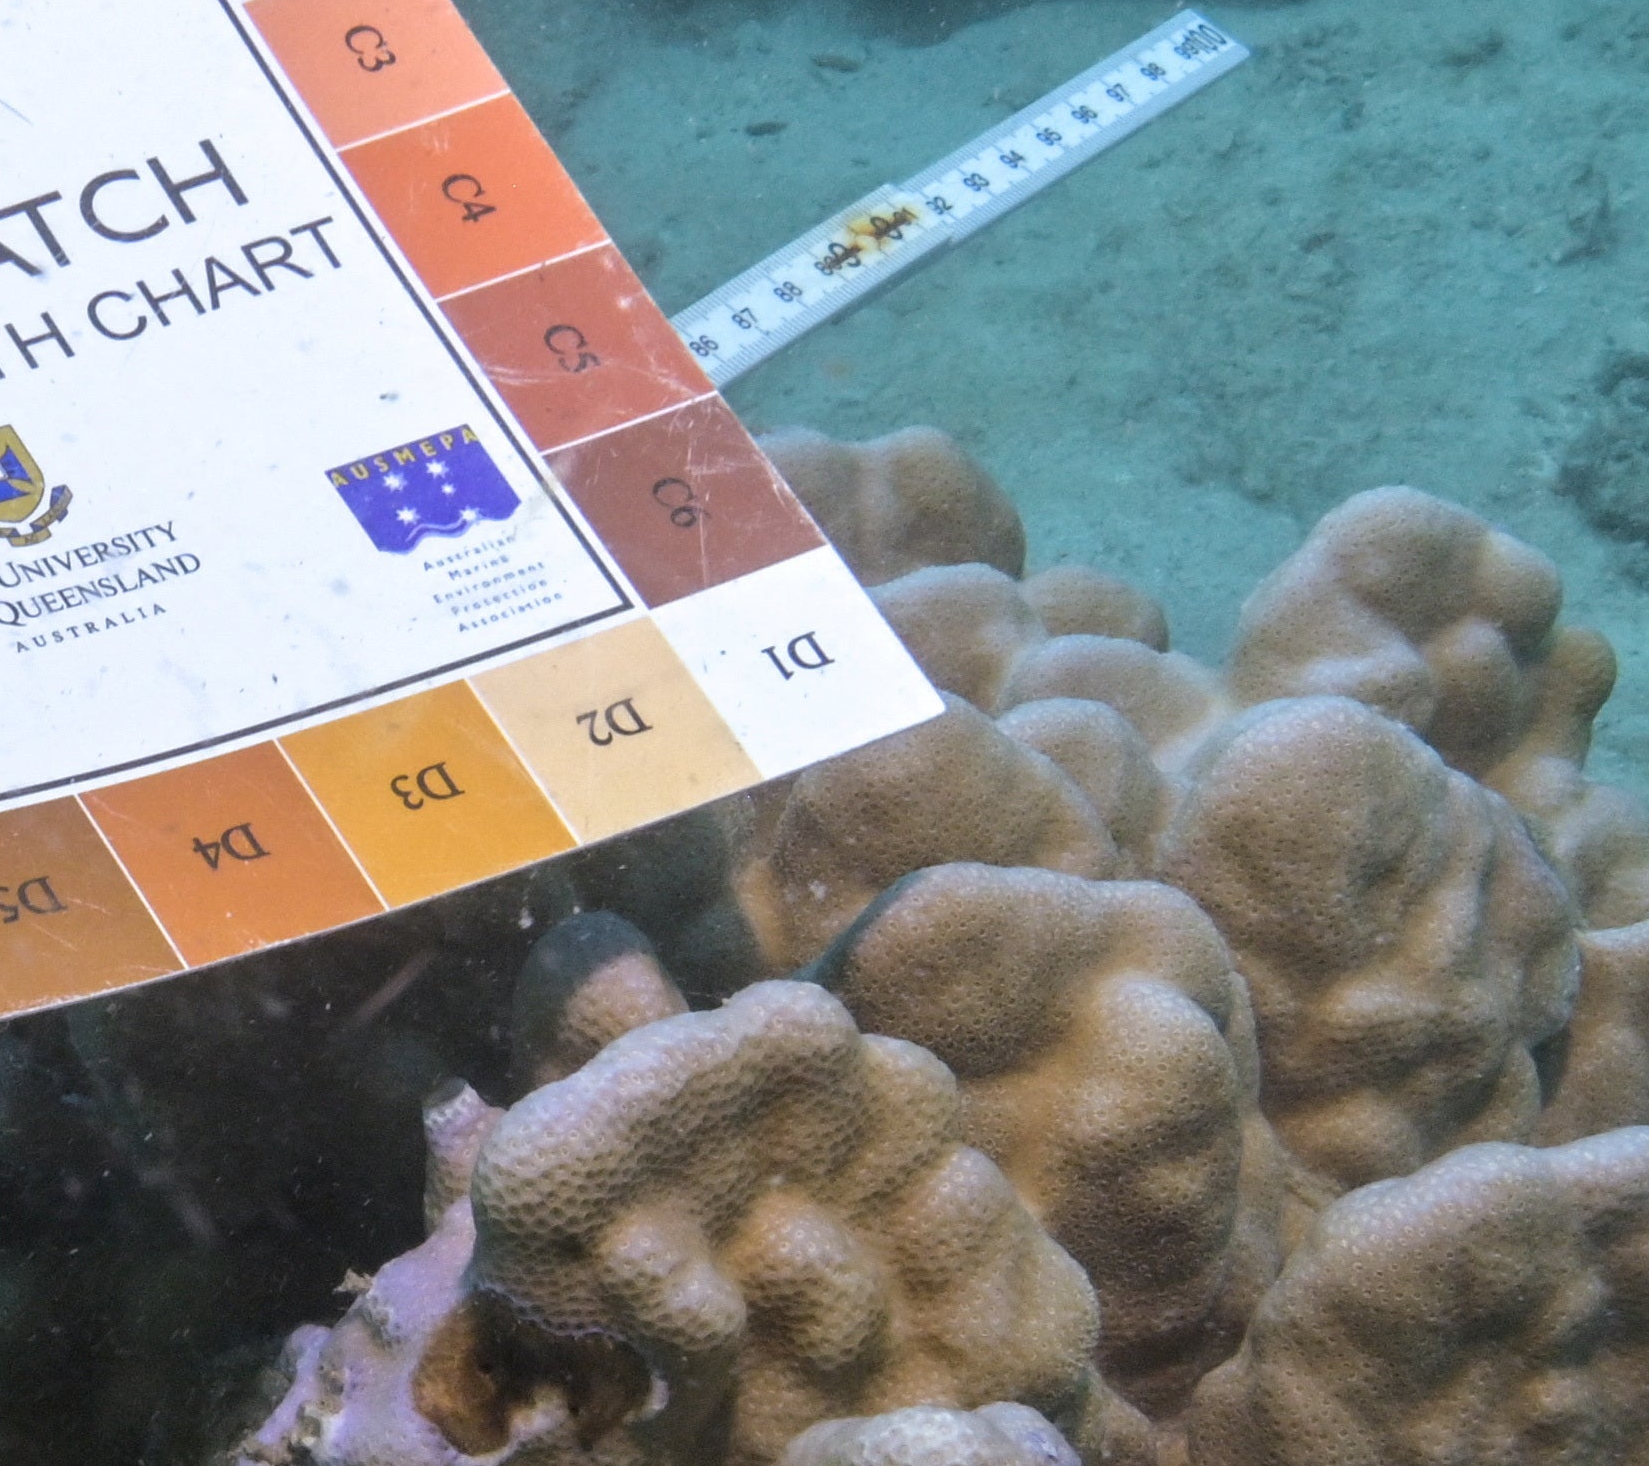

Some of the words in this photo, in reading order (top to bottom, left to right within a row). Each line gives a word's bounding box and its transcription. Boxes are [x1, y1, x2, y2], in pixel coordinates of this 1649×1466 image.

[344, 24, 396, 74] C3
[440, 173, 497, 225] C4
[86, 216, 347, 342] CHART
[542, 323, 600, 376] C5
[330, 428, 478, 487] AUSMEPA
[652, 476, 705, 531] C6
[15, 601, 167, 654] AUSTRALIA
[761, 630, 836, 683] D1
[575, 696, 654, 749] D2
[389, 760, 467, 812] D3
[192, 821, 272, 873] D4
